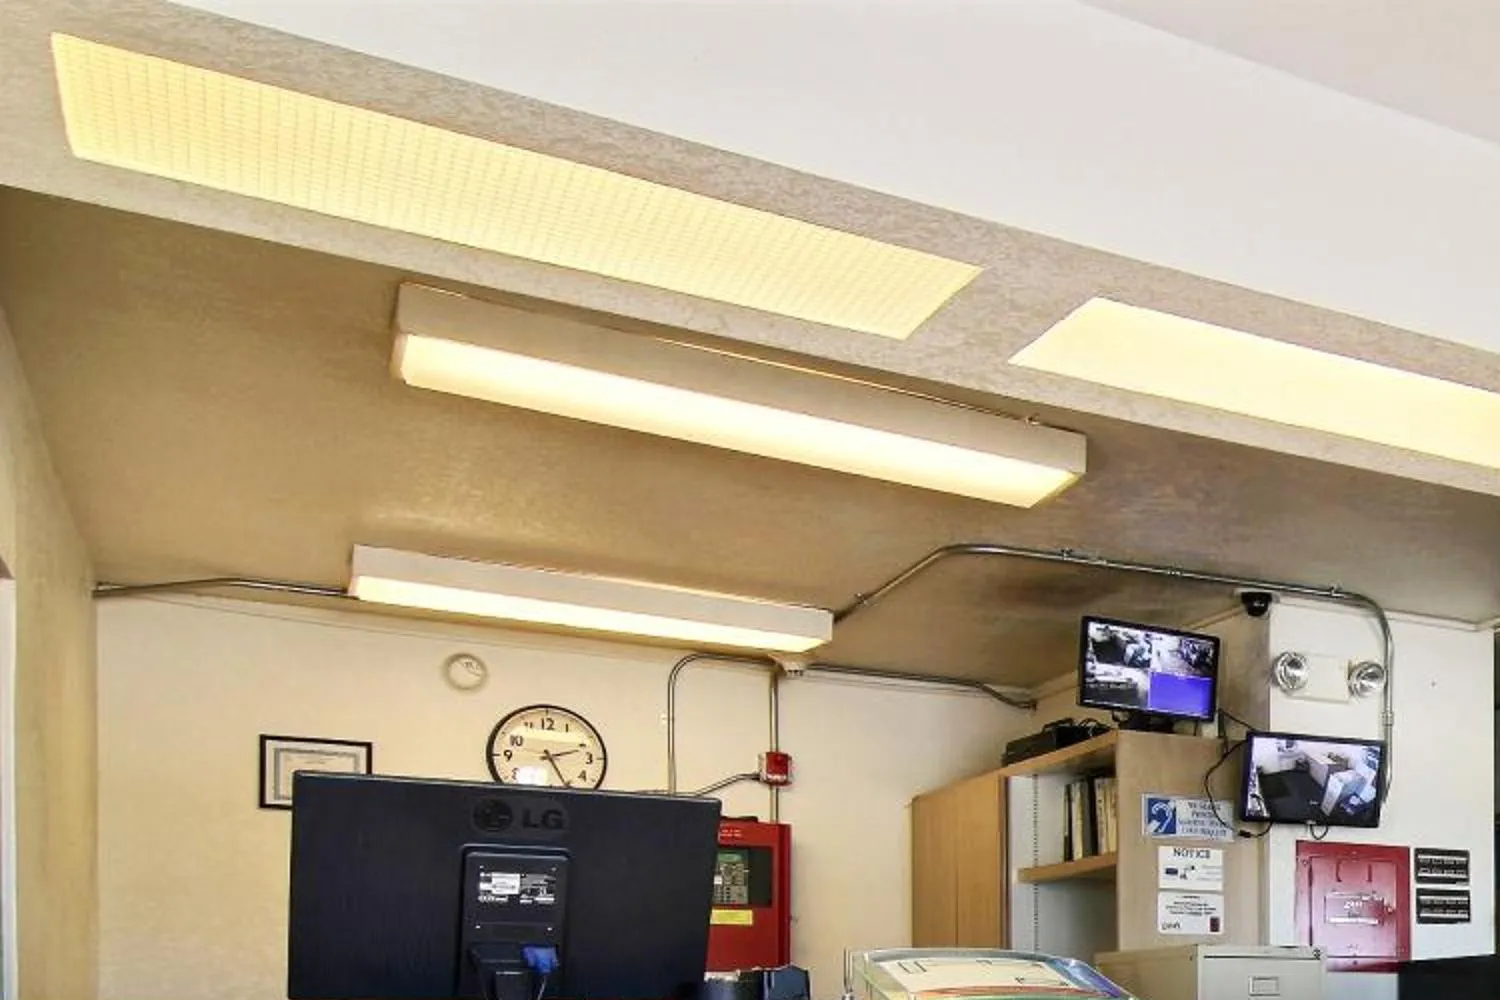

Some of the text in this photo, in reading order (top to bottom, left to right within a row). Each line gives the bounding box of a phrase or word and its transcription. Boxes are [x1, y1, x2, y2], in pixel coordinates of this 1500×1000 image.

[540, 717, 555, 731] 12
[509, 735, 523, 747] 10
[503, 749, 513, 762] 9
[585, 751, 593, 765] 3
[577, 770, 587, 782] 4
[522, 808, 563, 829] LG
[1173, 847, 1210, 859] NOTICE
